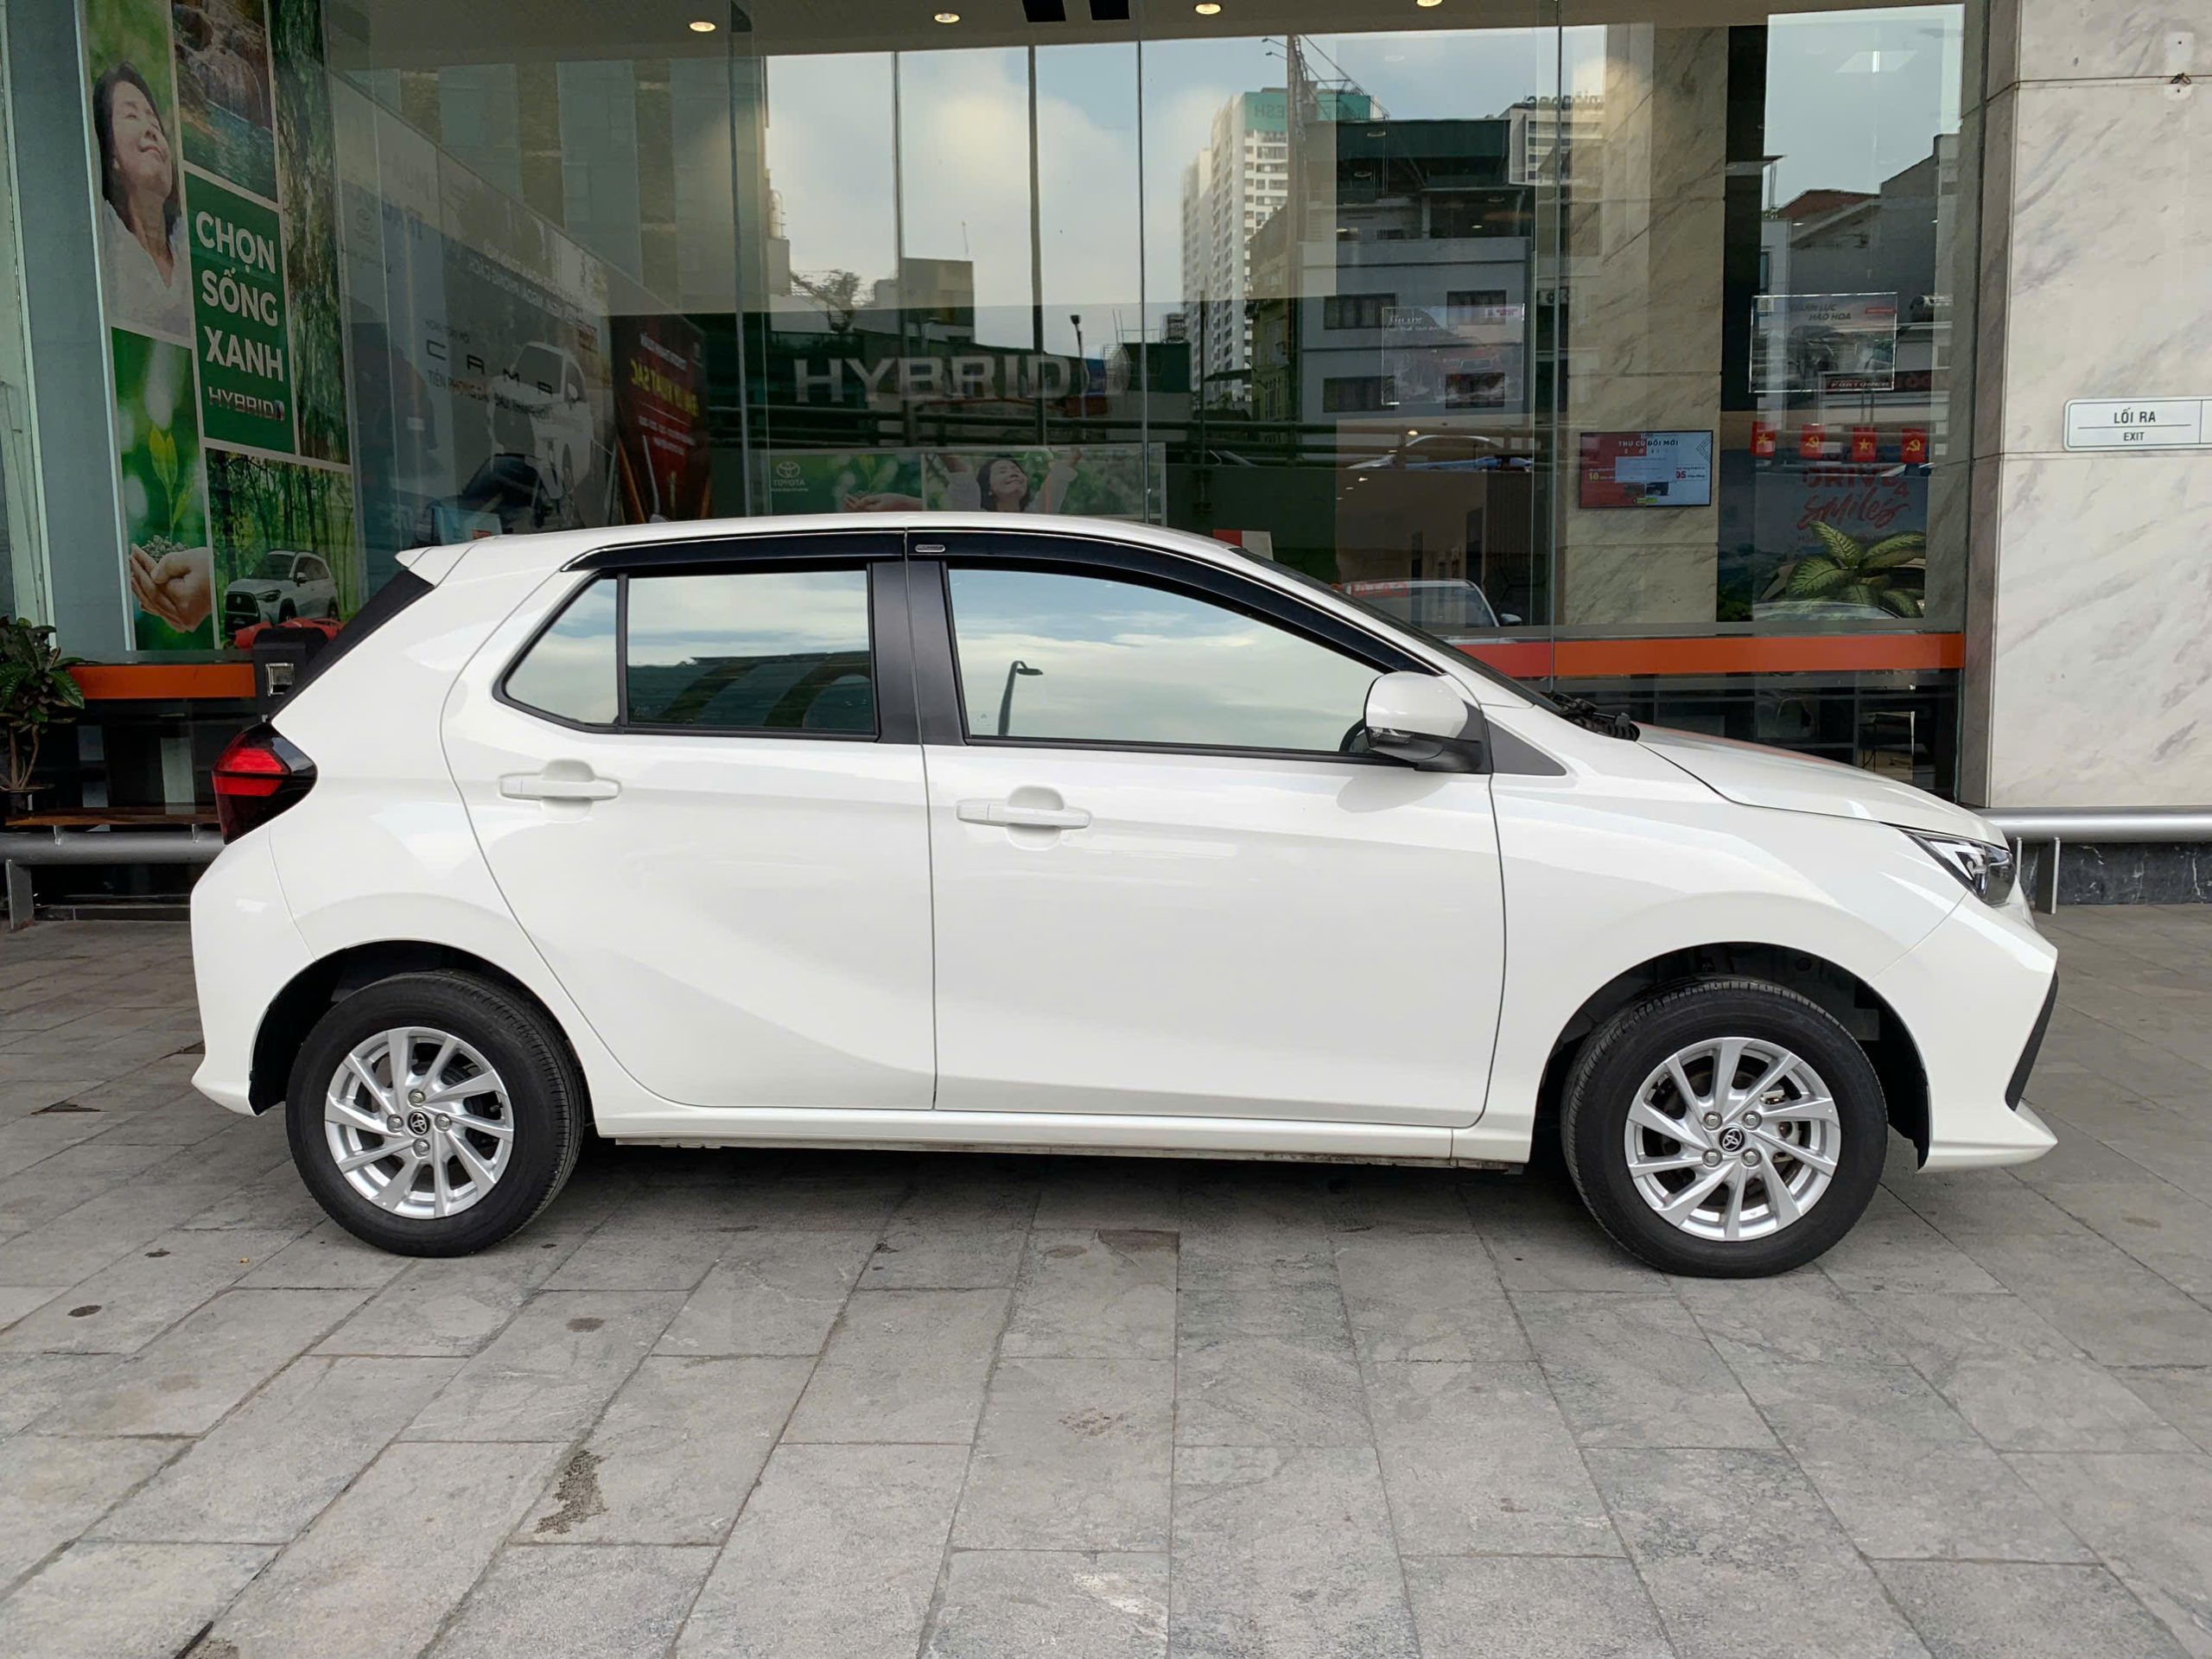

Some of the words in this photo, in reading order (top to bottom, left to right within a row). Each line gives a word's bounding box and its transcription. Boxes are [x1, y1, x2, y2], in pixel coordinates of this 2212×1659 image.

[195, 210, 276, 275] CHỌN
[201, 267, 278, 327] SỐNG
[204, 325, 283, 383] XANH
[793, 354, 1071, 404] HYBRID
[207, 385, 275, 421] HYBRID
[2113, 407, 2133, 423] LỐI
[2139, 410, 2157, 423] RA
[2123, 431, 2145, 442] EXIT
